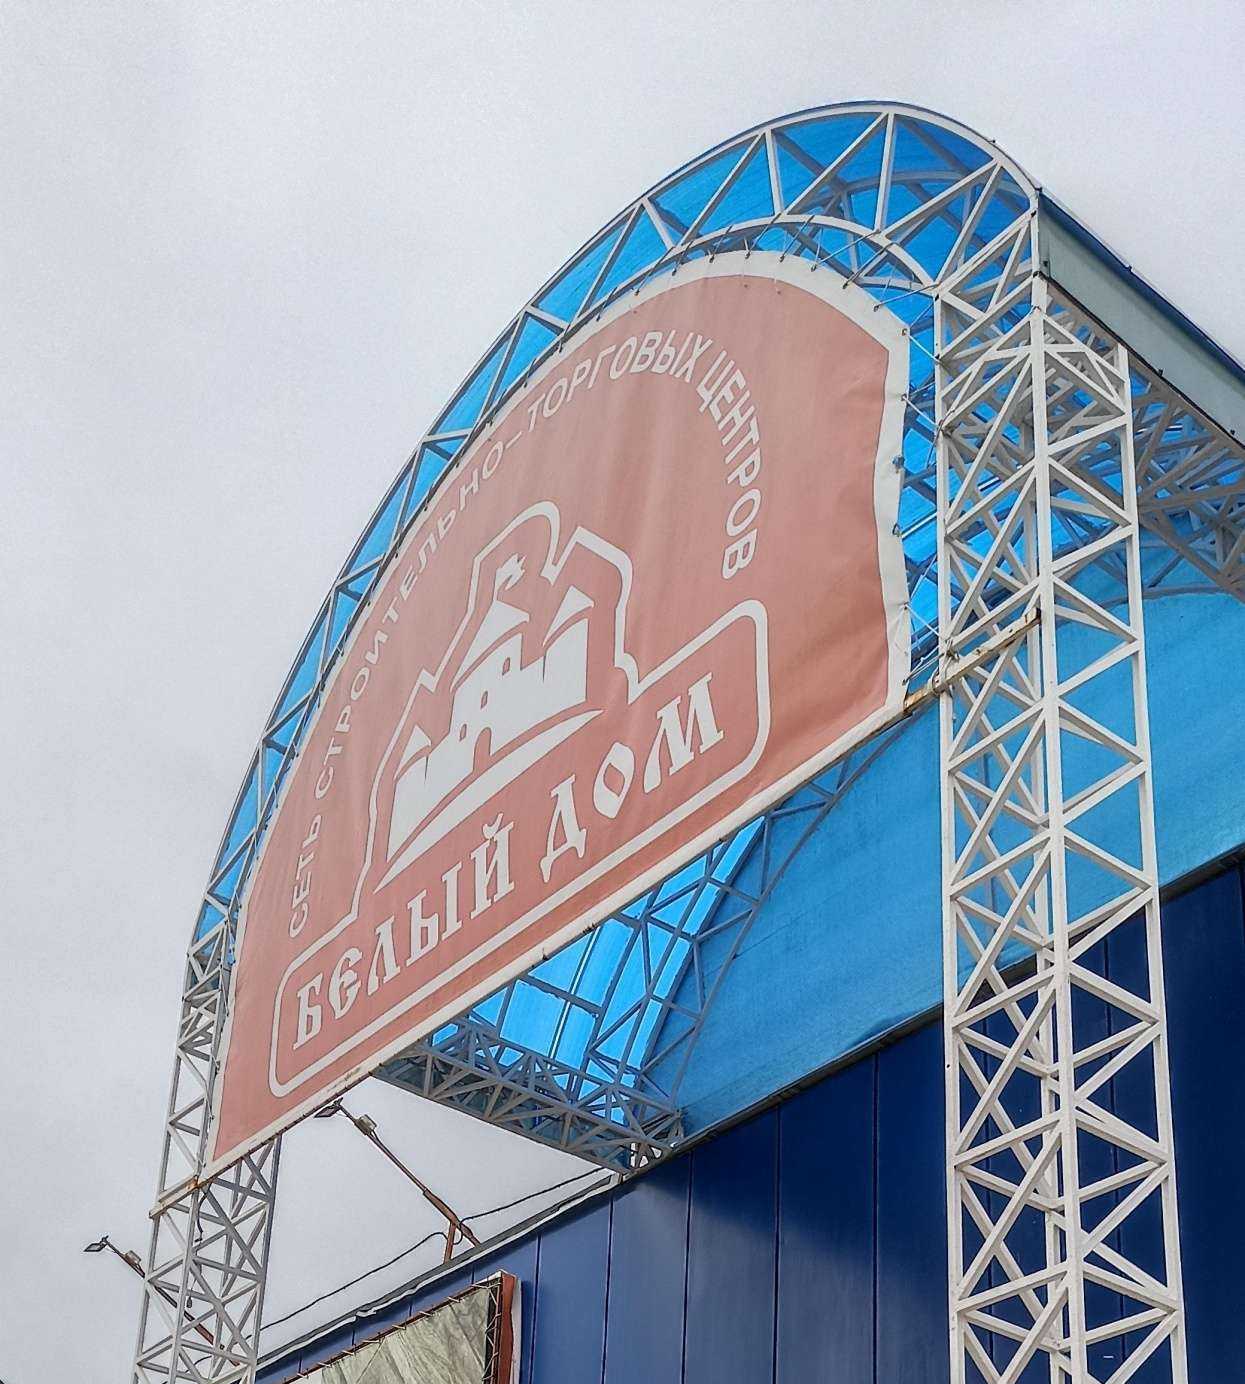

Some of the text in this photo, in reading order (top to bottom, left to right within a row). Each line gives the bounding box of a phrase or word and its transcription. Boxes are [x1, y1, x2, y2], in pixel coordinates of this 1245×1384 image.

[288, 813, 322, 939] СЕТЬ
[696, 350, 762, 580] ЦЕНТРОВ
[292, 672, 725, 1050] БЕЛЫЙ ДОМ
